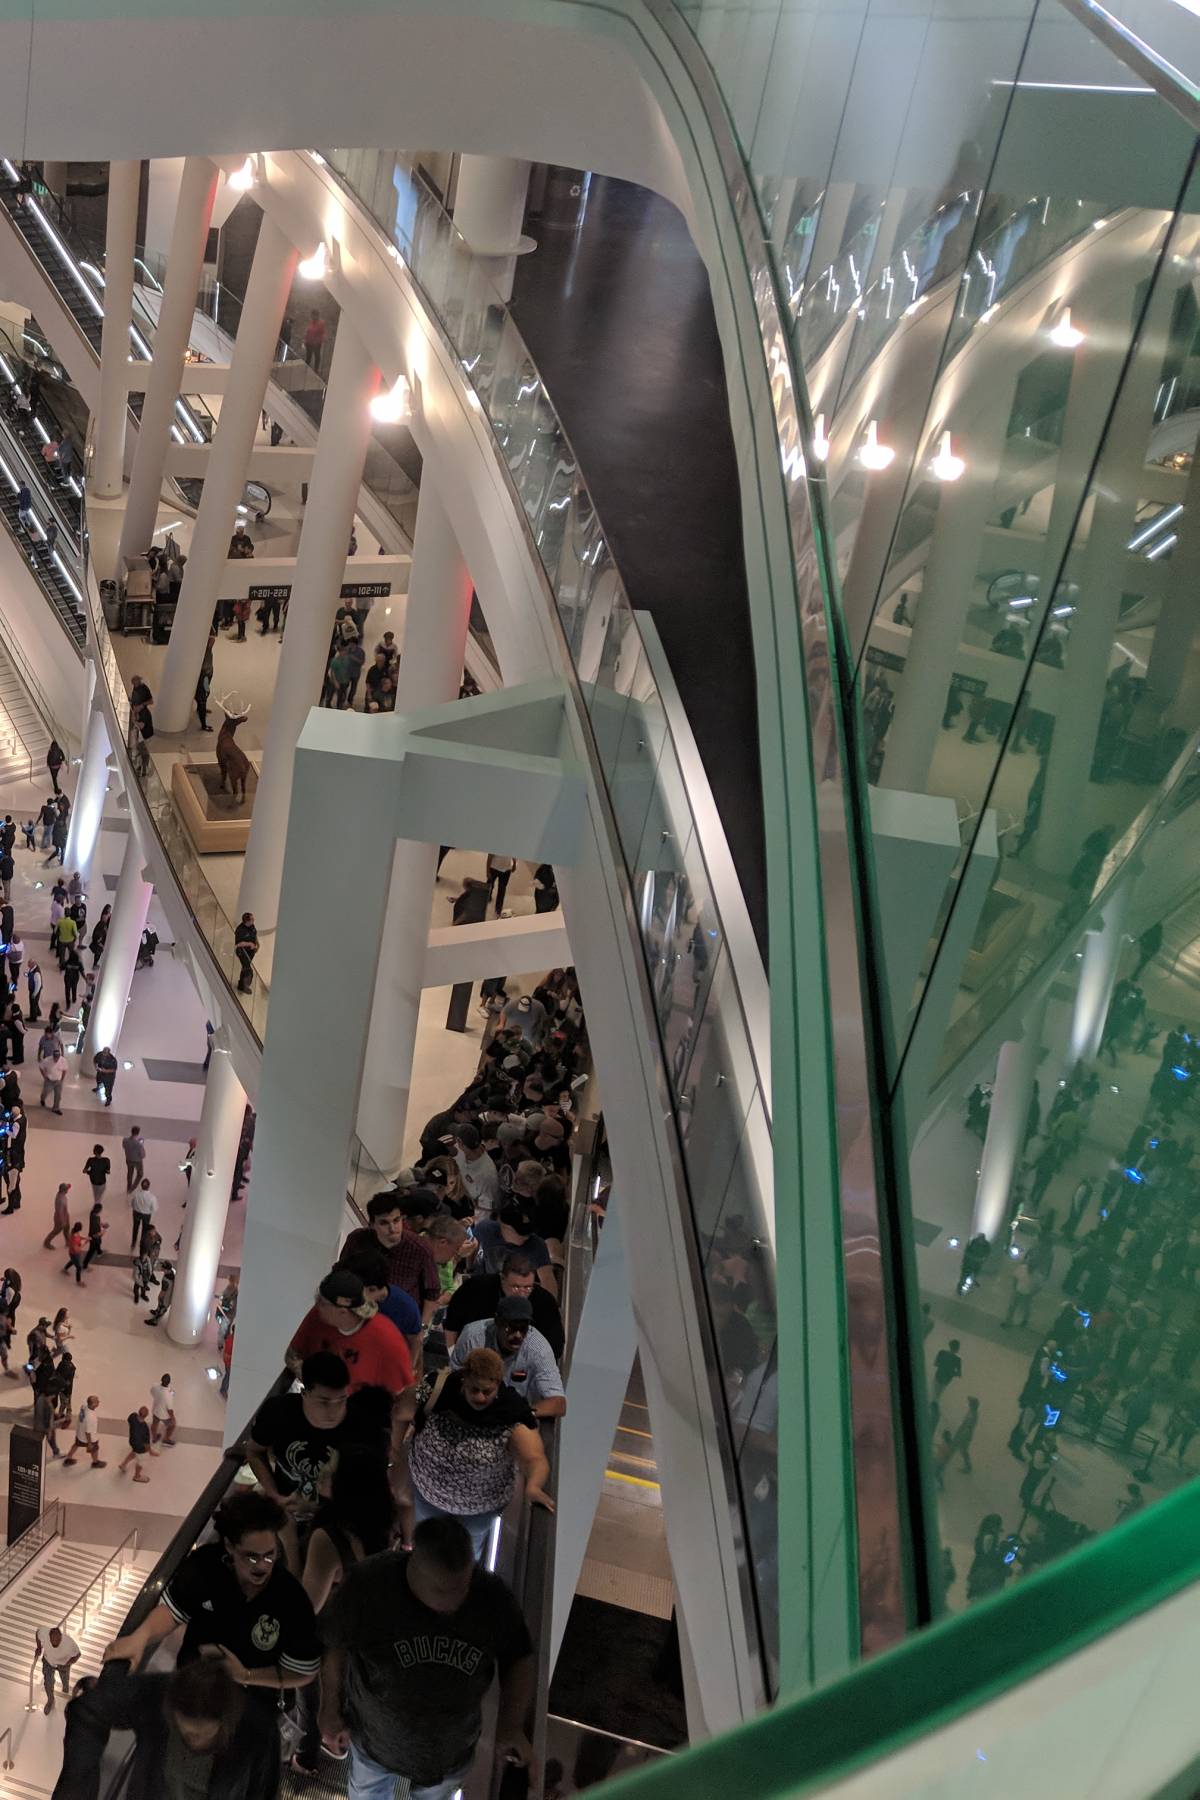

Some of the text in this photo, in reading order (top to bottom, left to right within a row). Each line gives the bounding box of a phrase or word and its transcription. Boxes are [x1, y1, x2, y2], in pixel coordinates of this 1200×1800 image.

[258, 588, 288, 598] 201-228
[358, 586, 382, 596] 102-111
[393, 1635, 484, 1676] BUCKS
